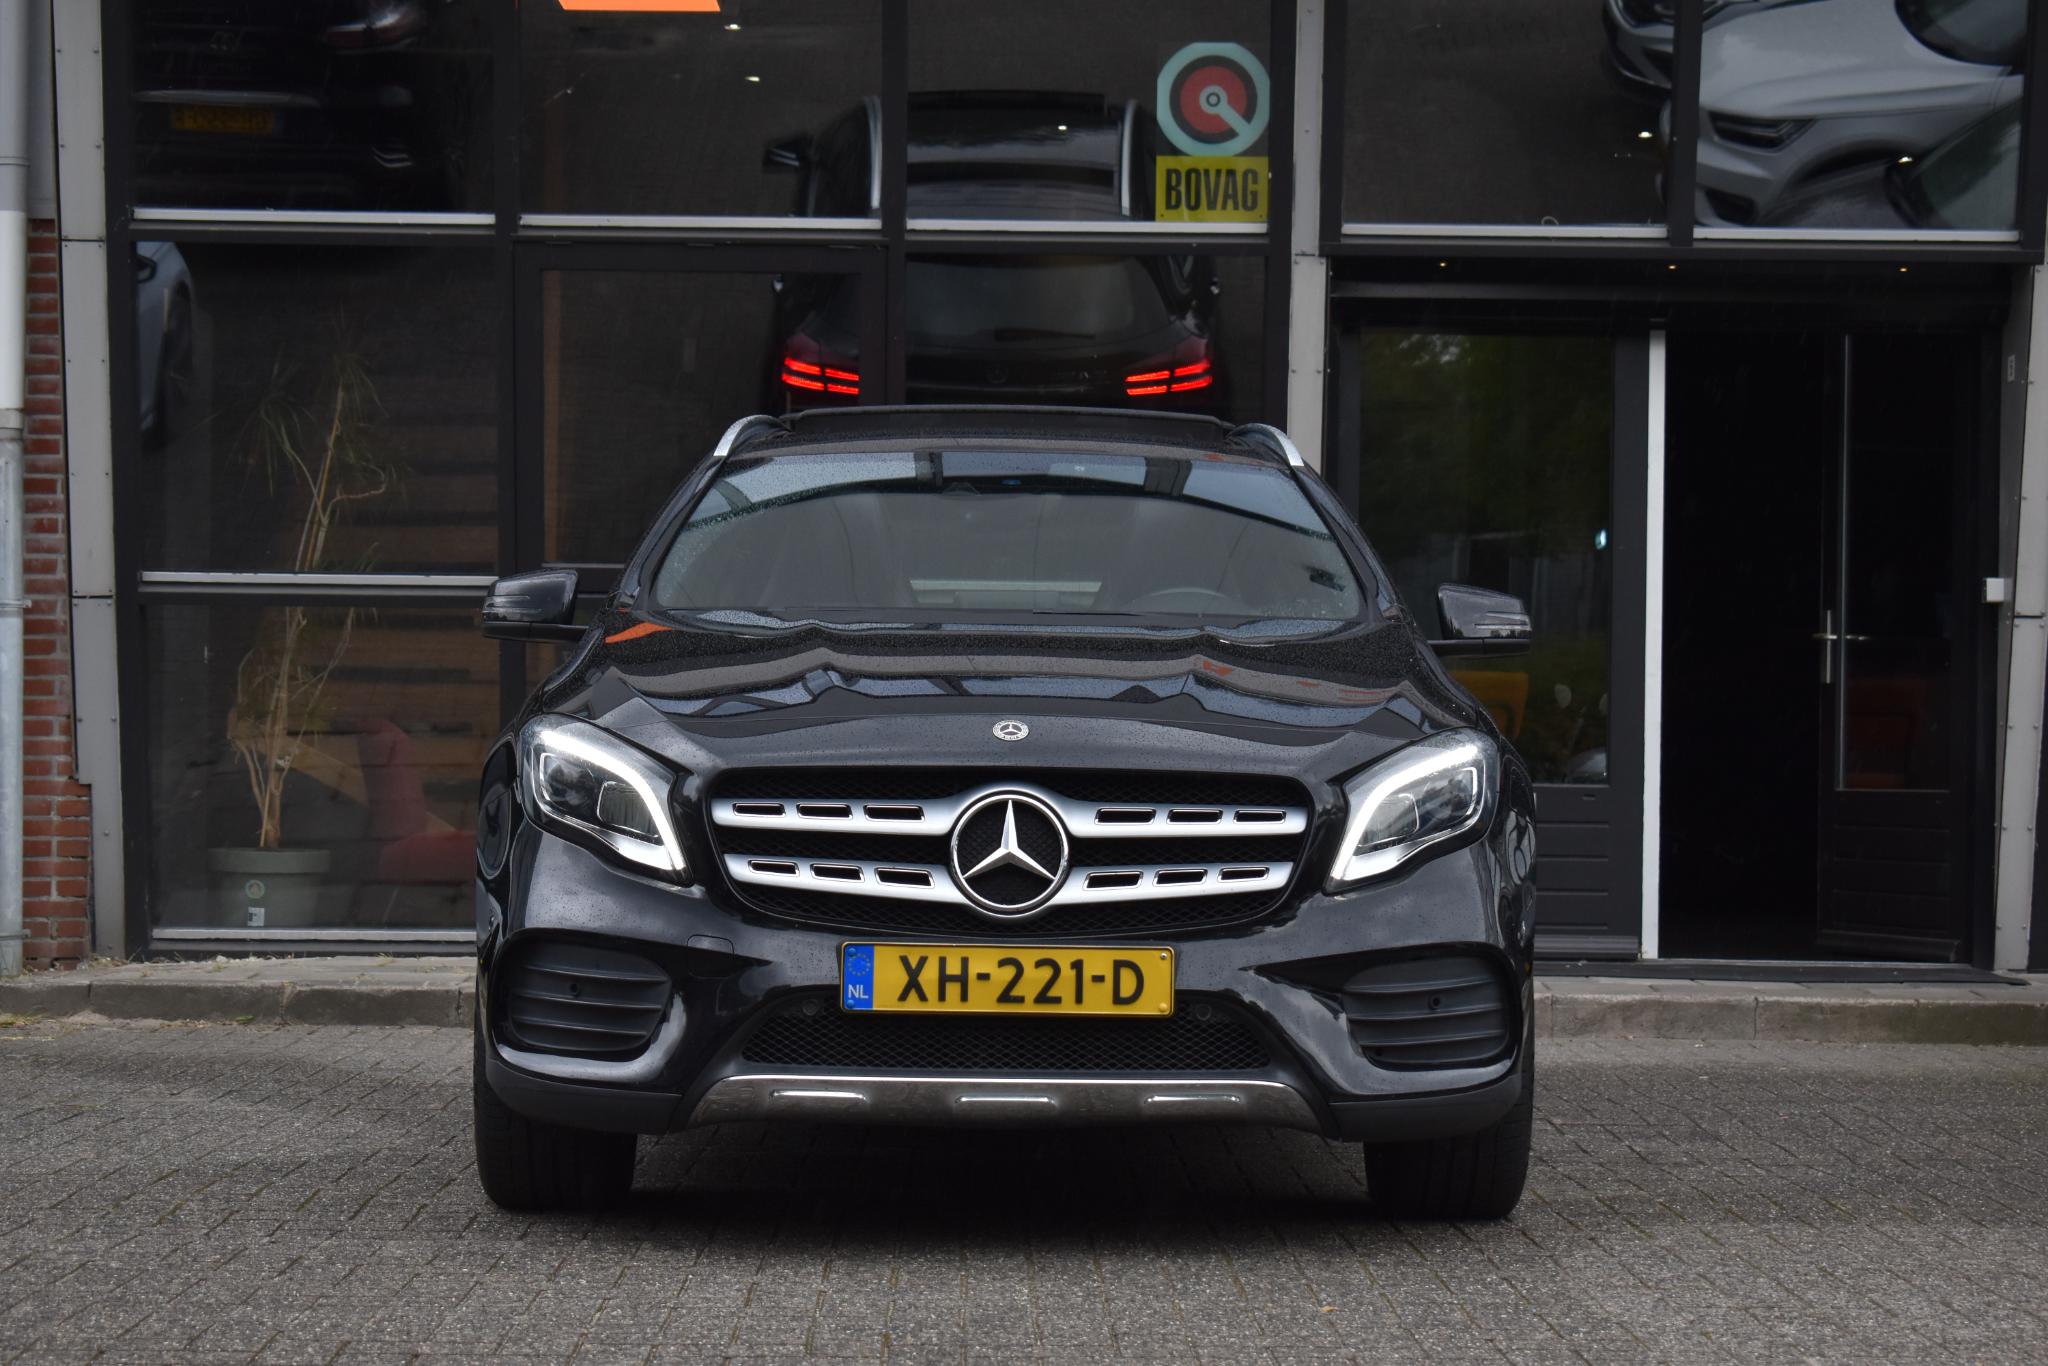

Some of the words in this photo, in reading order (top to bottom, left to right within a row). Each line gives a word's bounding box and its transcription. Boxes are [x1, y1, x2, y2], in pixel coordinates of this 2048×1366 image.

[1165, 168, 1259, 211] BOVAG
[848, 984, 869, 999] NL
[898, 954, 1145, 1006] XH-221-D
